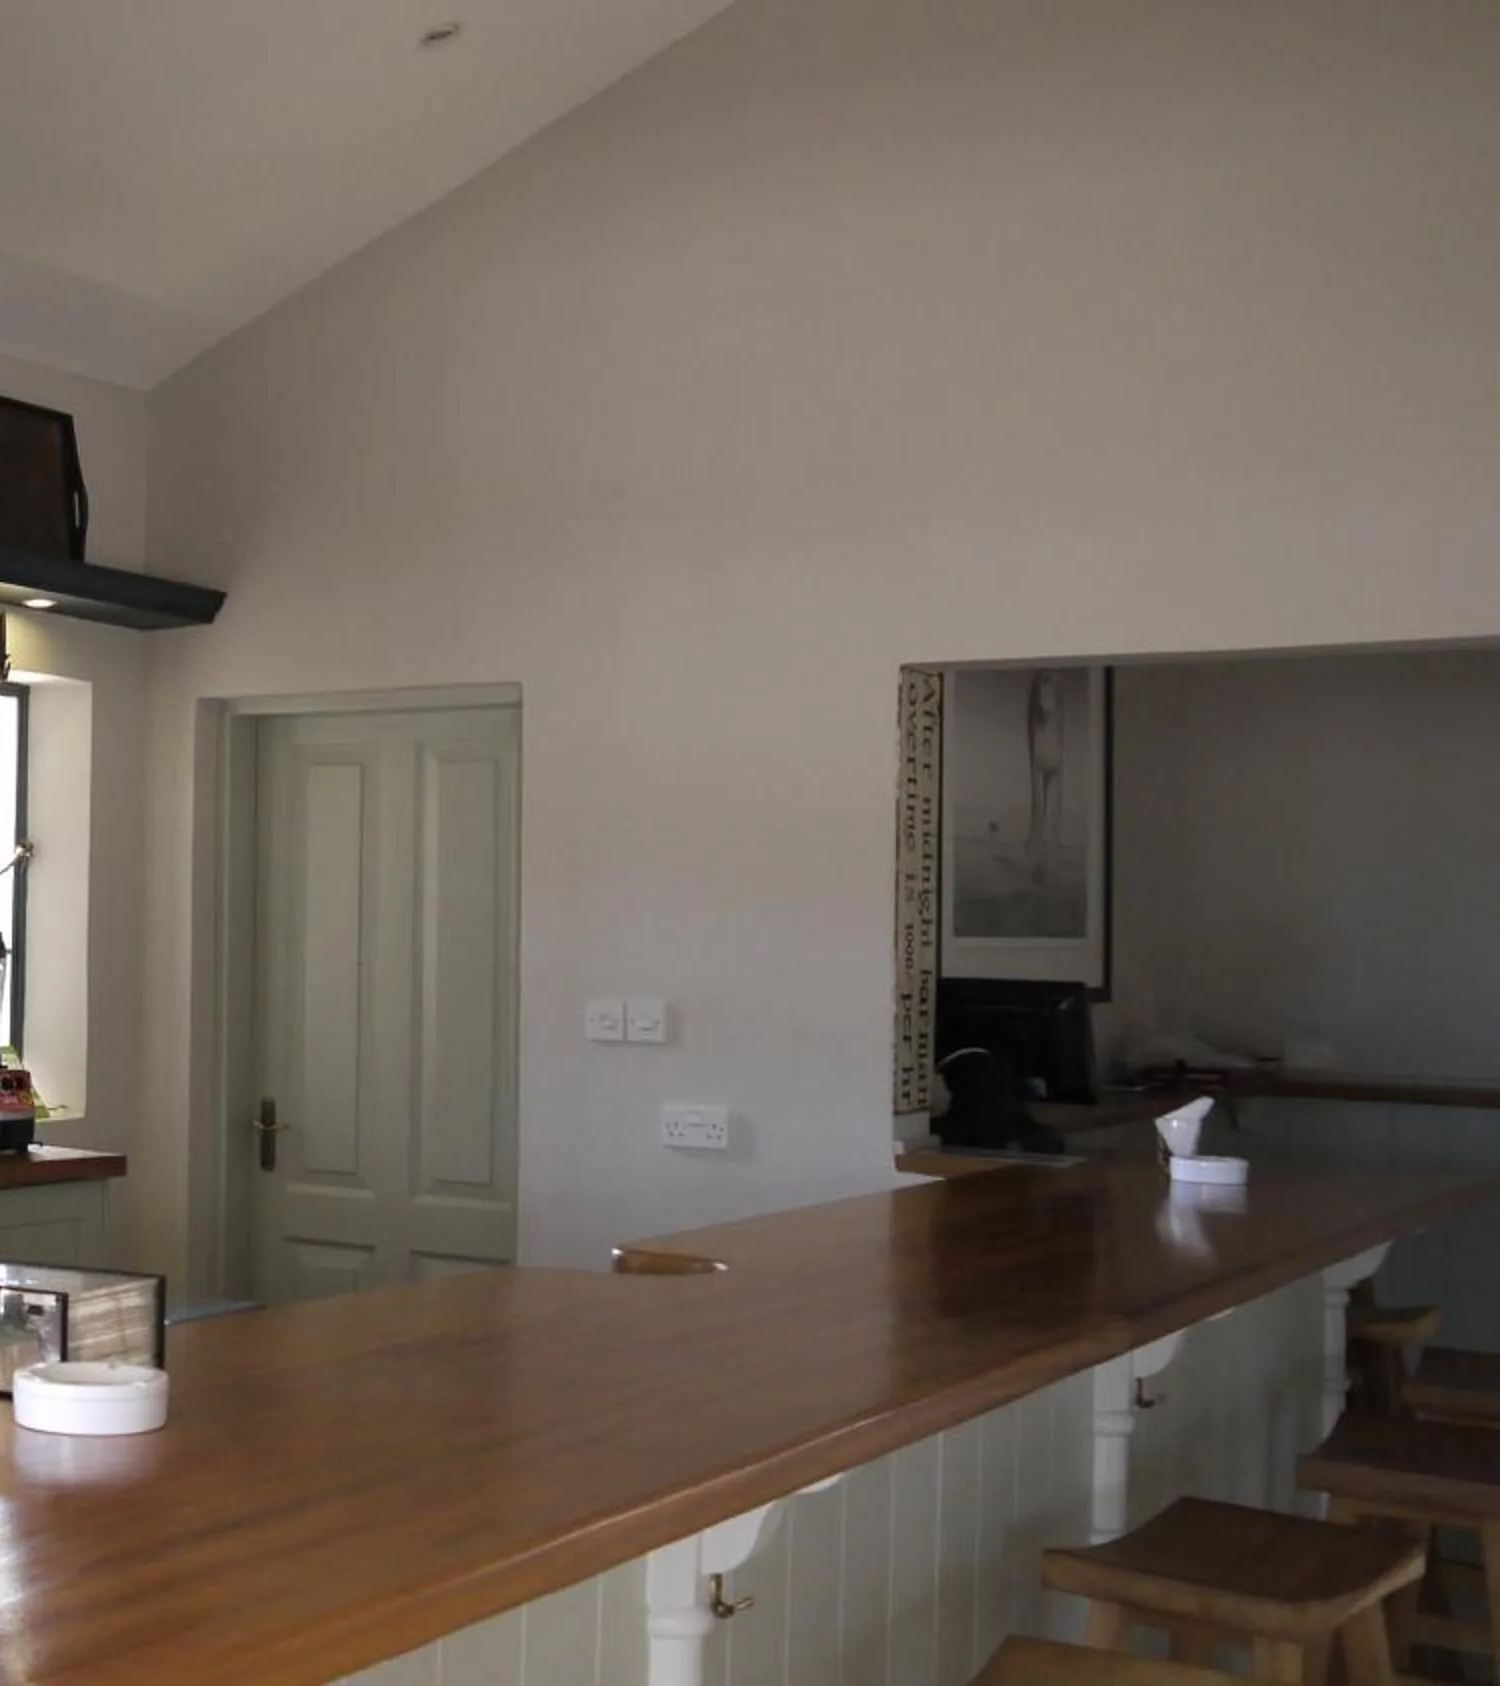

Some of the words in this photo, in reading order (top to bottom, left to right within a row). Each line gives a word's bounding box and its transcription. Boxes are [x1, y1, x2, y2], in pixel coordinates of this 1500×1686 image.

[906, 682, 919, 852] overtime
[920, 676, 937, 779] After
[918, 797, 935, 947] midnight
[901, 993, 914, 1050] per
[901, 1066, 916, 1104] hr
